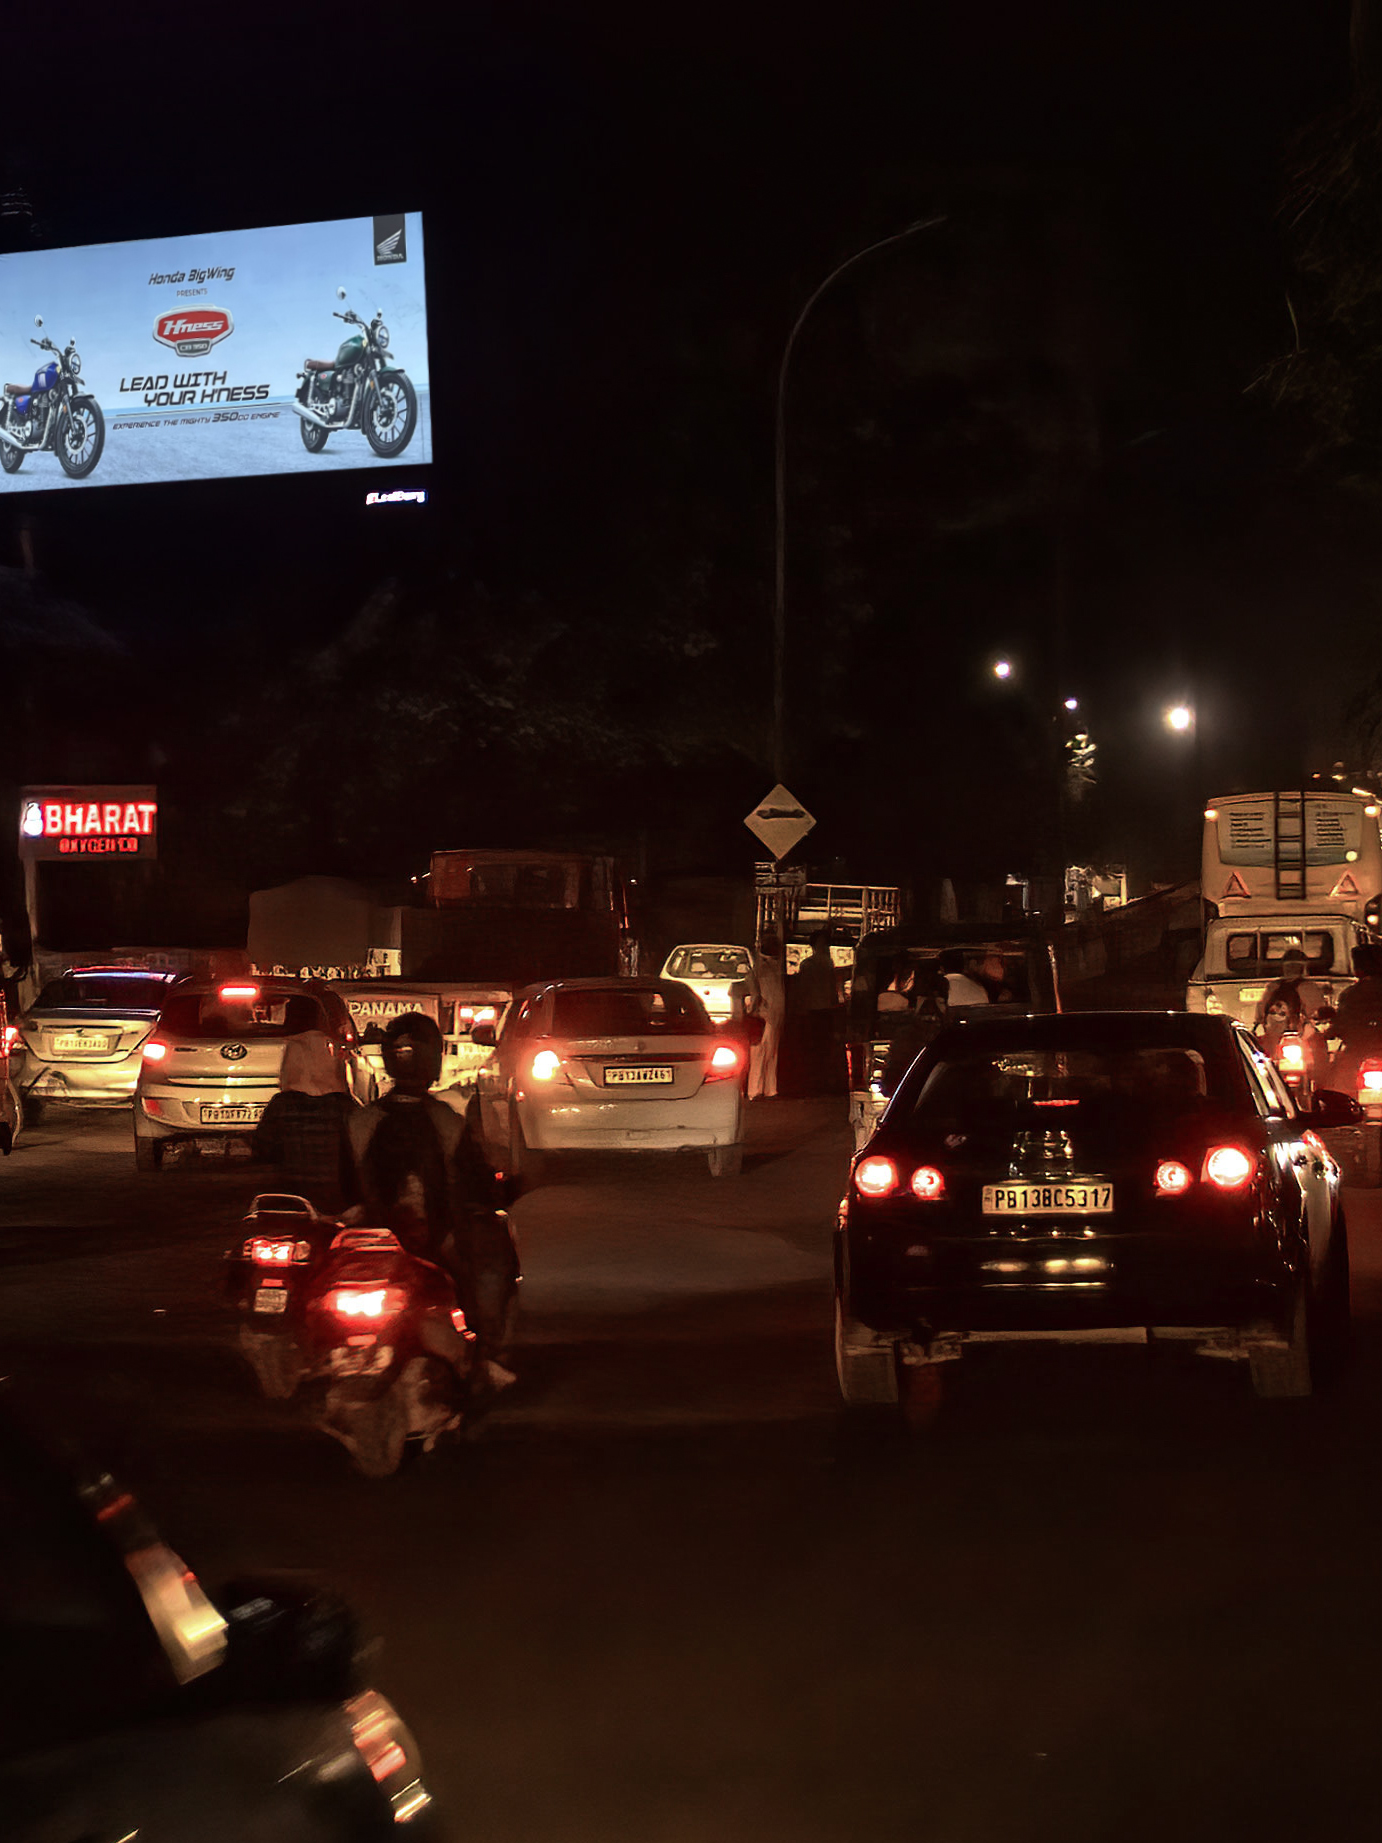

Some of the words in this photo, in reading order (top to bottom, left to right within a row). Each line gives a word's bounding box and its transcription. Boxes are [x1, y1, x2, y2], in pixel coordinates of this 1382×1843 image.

[148, 270, 185, 285] Honda
[188, 266, 235, 284] BigWing
[176, 288, 208, 297] PRESENTS
[120, 375, 168, 392] LEAD
[173, 371, 227, 388] WITH
[144, 390, 196, 407] YOUR
[113, 420, 161, 430] EXPERIENCE
[163, 419, 178, 427] THE
[180, 417, 211, 425] MIGHTY
[251, 411, 281, 420] ENGINE
[45, 803, 157, 834] BHARAT
[348, 1001, 424, 1017] PANAMA
[995, 1188, 1111, 1209] PB13BC5317
